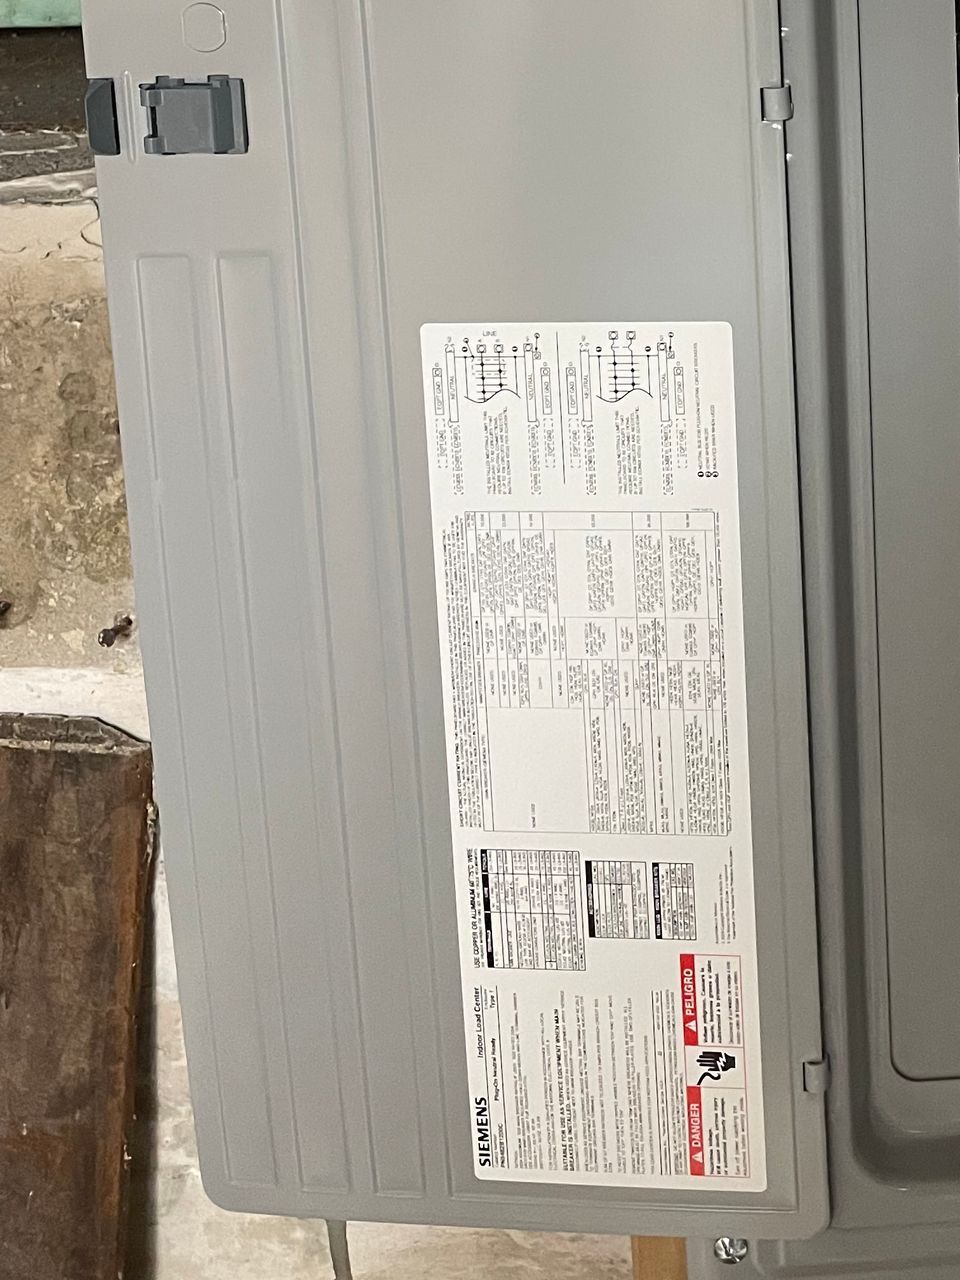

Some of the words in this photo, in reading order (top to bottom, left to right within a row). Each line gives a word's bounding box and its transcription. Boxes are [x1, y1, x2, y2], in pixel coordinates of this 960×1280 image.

[472, 921, 478, 930] OR
[473, 987, 481, 1012] Center
[683, 968, 695, 1016] PELIGRO
[474, 1014, 482, 1032] Load
[476, 1035, 484, 1058] Indoor
[559, 1107, 565, 1115] AS
[474, 1097, 491, 1167] SIEMENS
[690, 1103, 701, 1147] DANGER
